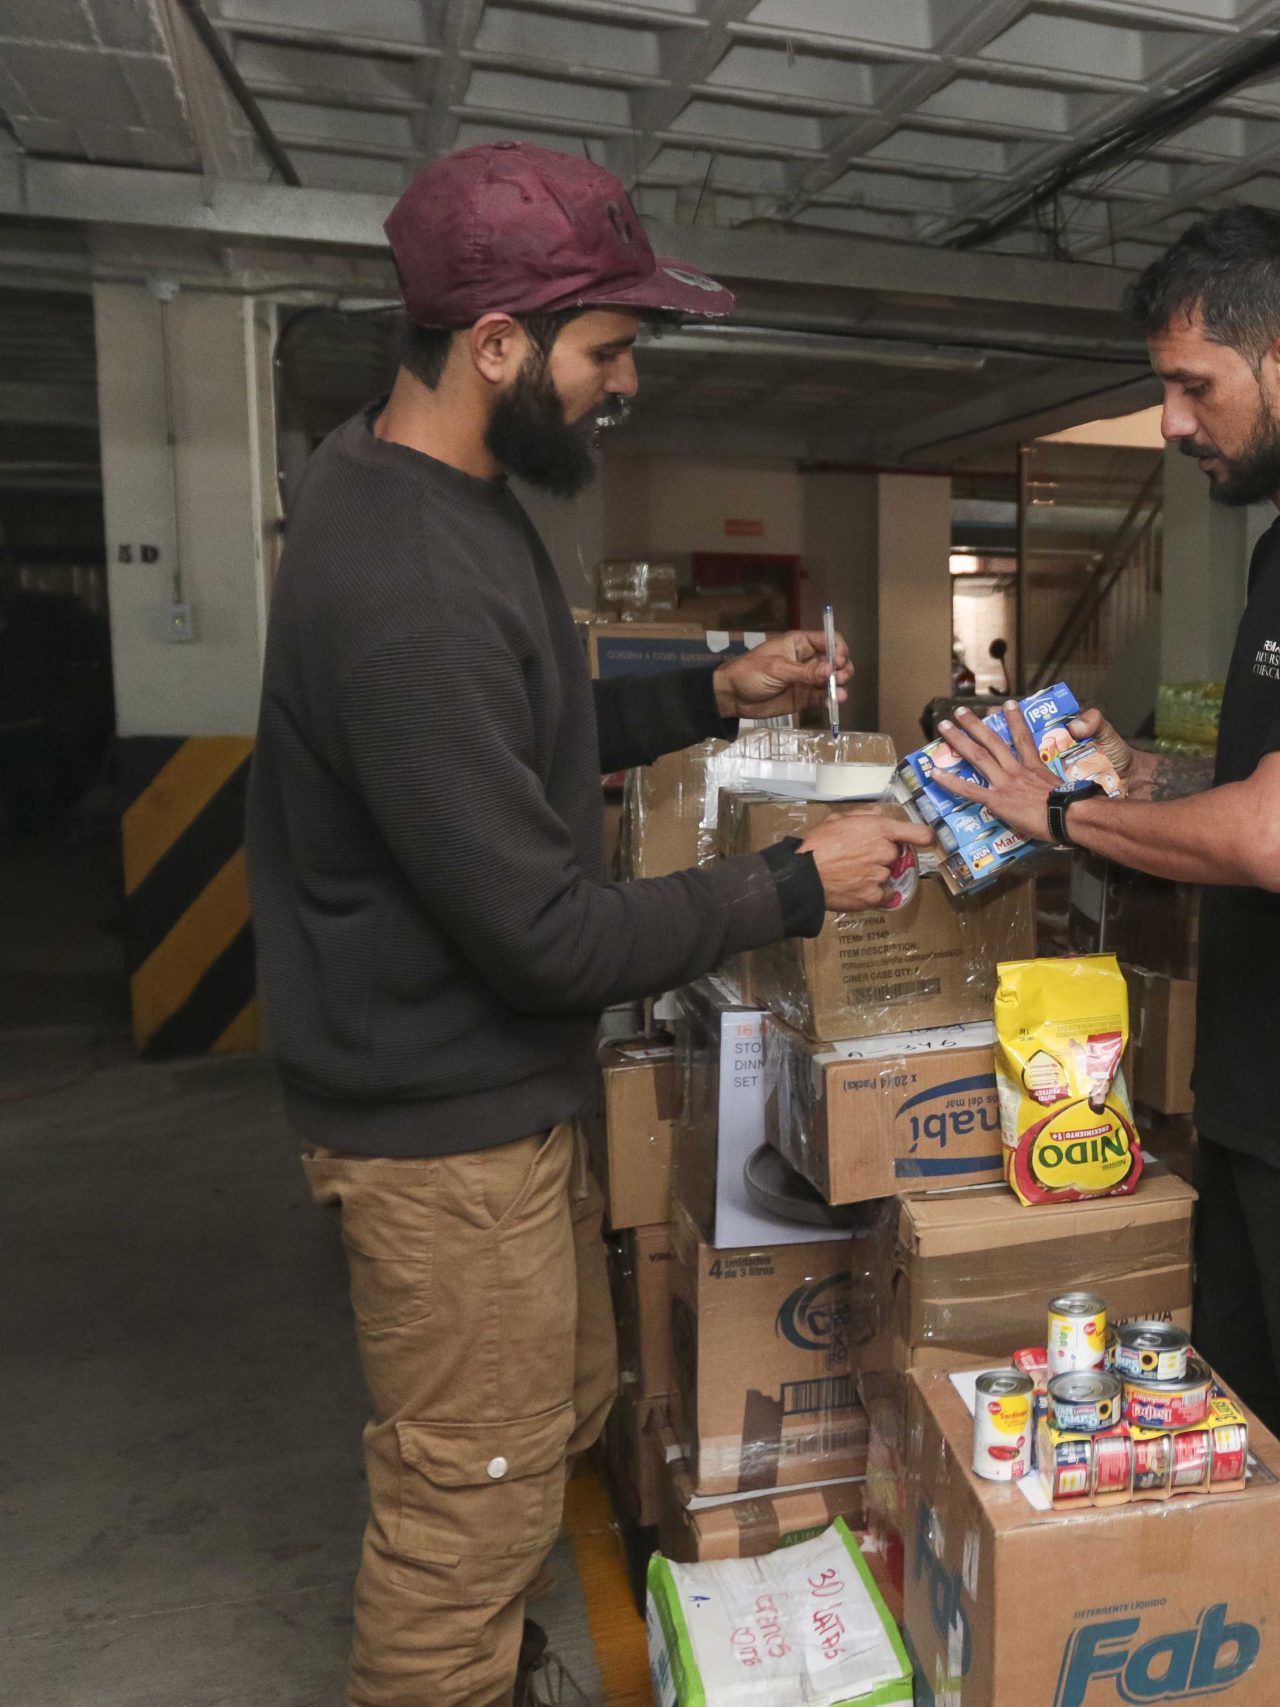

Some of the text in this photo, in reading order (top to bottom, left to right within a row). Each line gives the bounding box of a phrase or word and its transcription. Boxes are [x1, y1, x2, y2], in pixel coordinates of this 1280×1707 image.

[1029, 701, 1058, 724] Real
[735, 1060, 765, 1071] DINN
[734, 1077, 757, 1088] SET
[894, 1074, 908, 1087] 20
[946, 1098, 968, 1109] mar
[968, 1095, 985, 1108] del
[1066, 1124, 1110, 1139] CRECIMIENTO
[1038, 1127, 1127, 1168] NIDO
[709, 1260, 724, 1280] 4
[725, 1268, 737, 1279] de
[740, 1267, 747, 1277] 3
[1074, 1598, 1167, 1620] DETERGENTE LÍQUIDO
[1052, 1602, 1262, 1707] Fab
